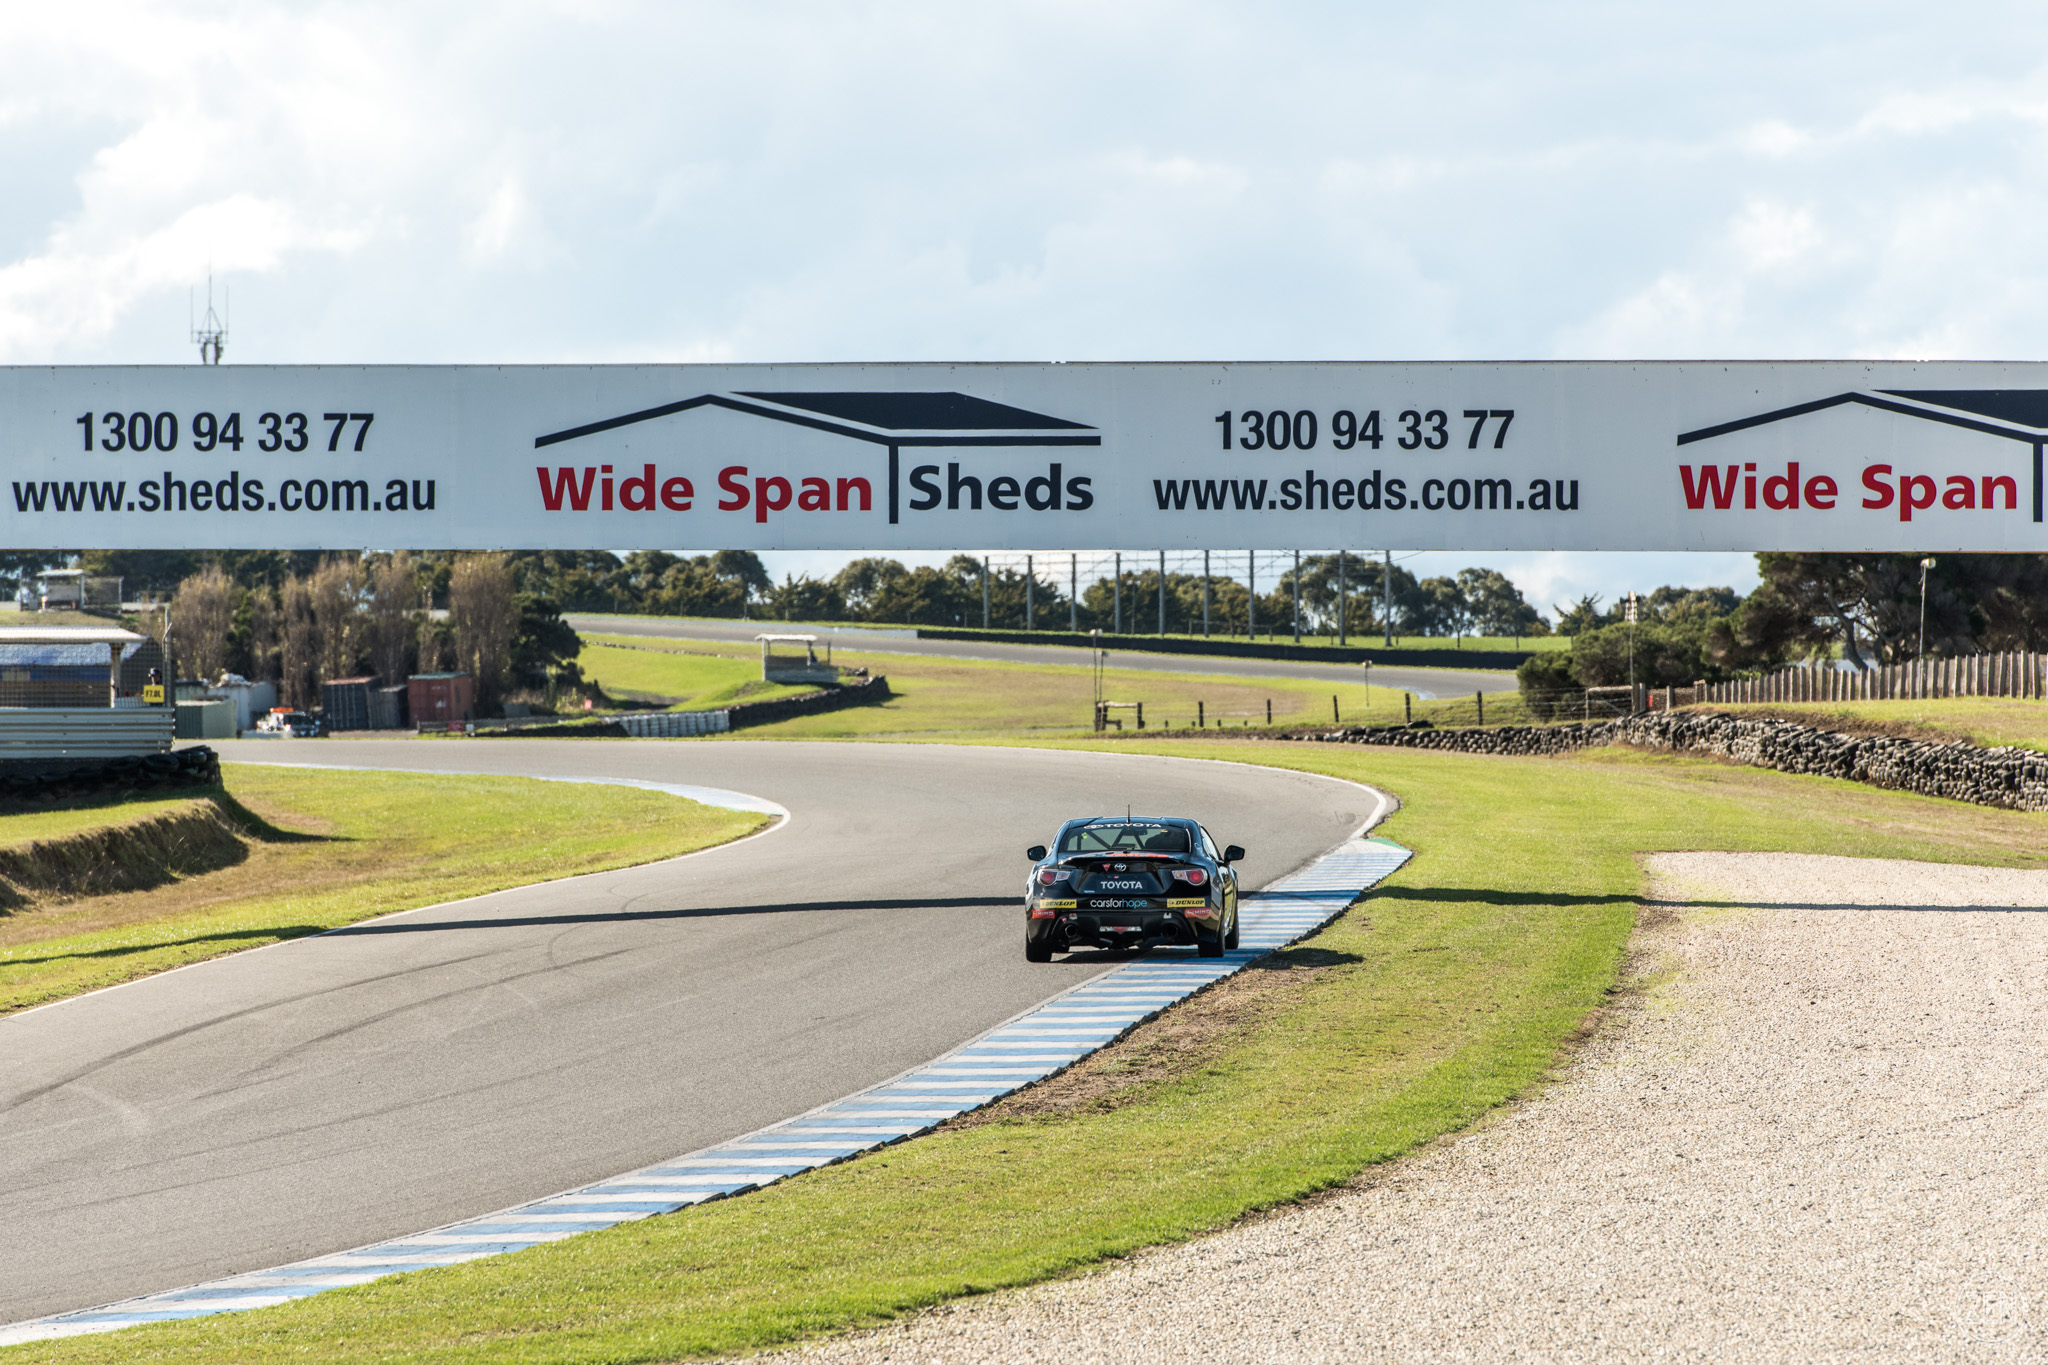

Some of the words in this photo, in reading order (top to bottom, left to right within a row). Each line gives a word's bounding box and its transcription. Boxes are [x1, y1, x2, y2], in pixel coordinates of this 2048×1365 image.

[76, 412, 179, 452] 1300
[192, 412, 243, 452] 94
[258, 412, 308, 452] 33
[324, 412, 375, 452] 77
[1215, 410, 1317, 450] 1300
[1332, 410, 1383, 450] 94
[1398, 410, 1448, 450] 33
[1463, 410, 1514, 450] 77
[12, 471, 436, 512] www.sheds.com.au
[536, 464, 694, 511] Wide
[718, 466, 872, 523] Span
[909, 463, 1093, 511] Sheds
[1153, 470, 1579, 511] www.sheds.com.au
[1679, 462, 1838, 510] Wide
[1862, 464, 2017, 522] Span
[1090, 898, 1148, 909] carsforhope
[1100, 881, 1143, 890] TOYOTA
